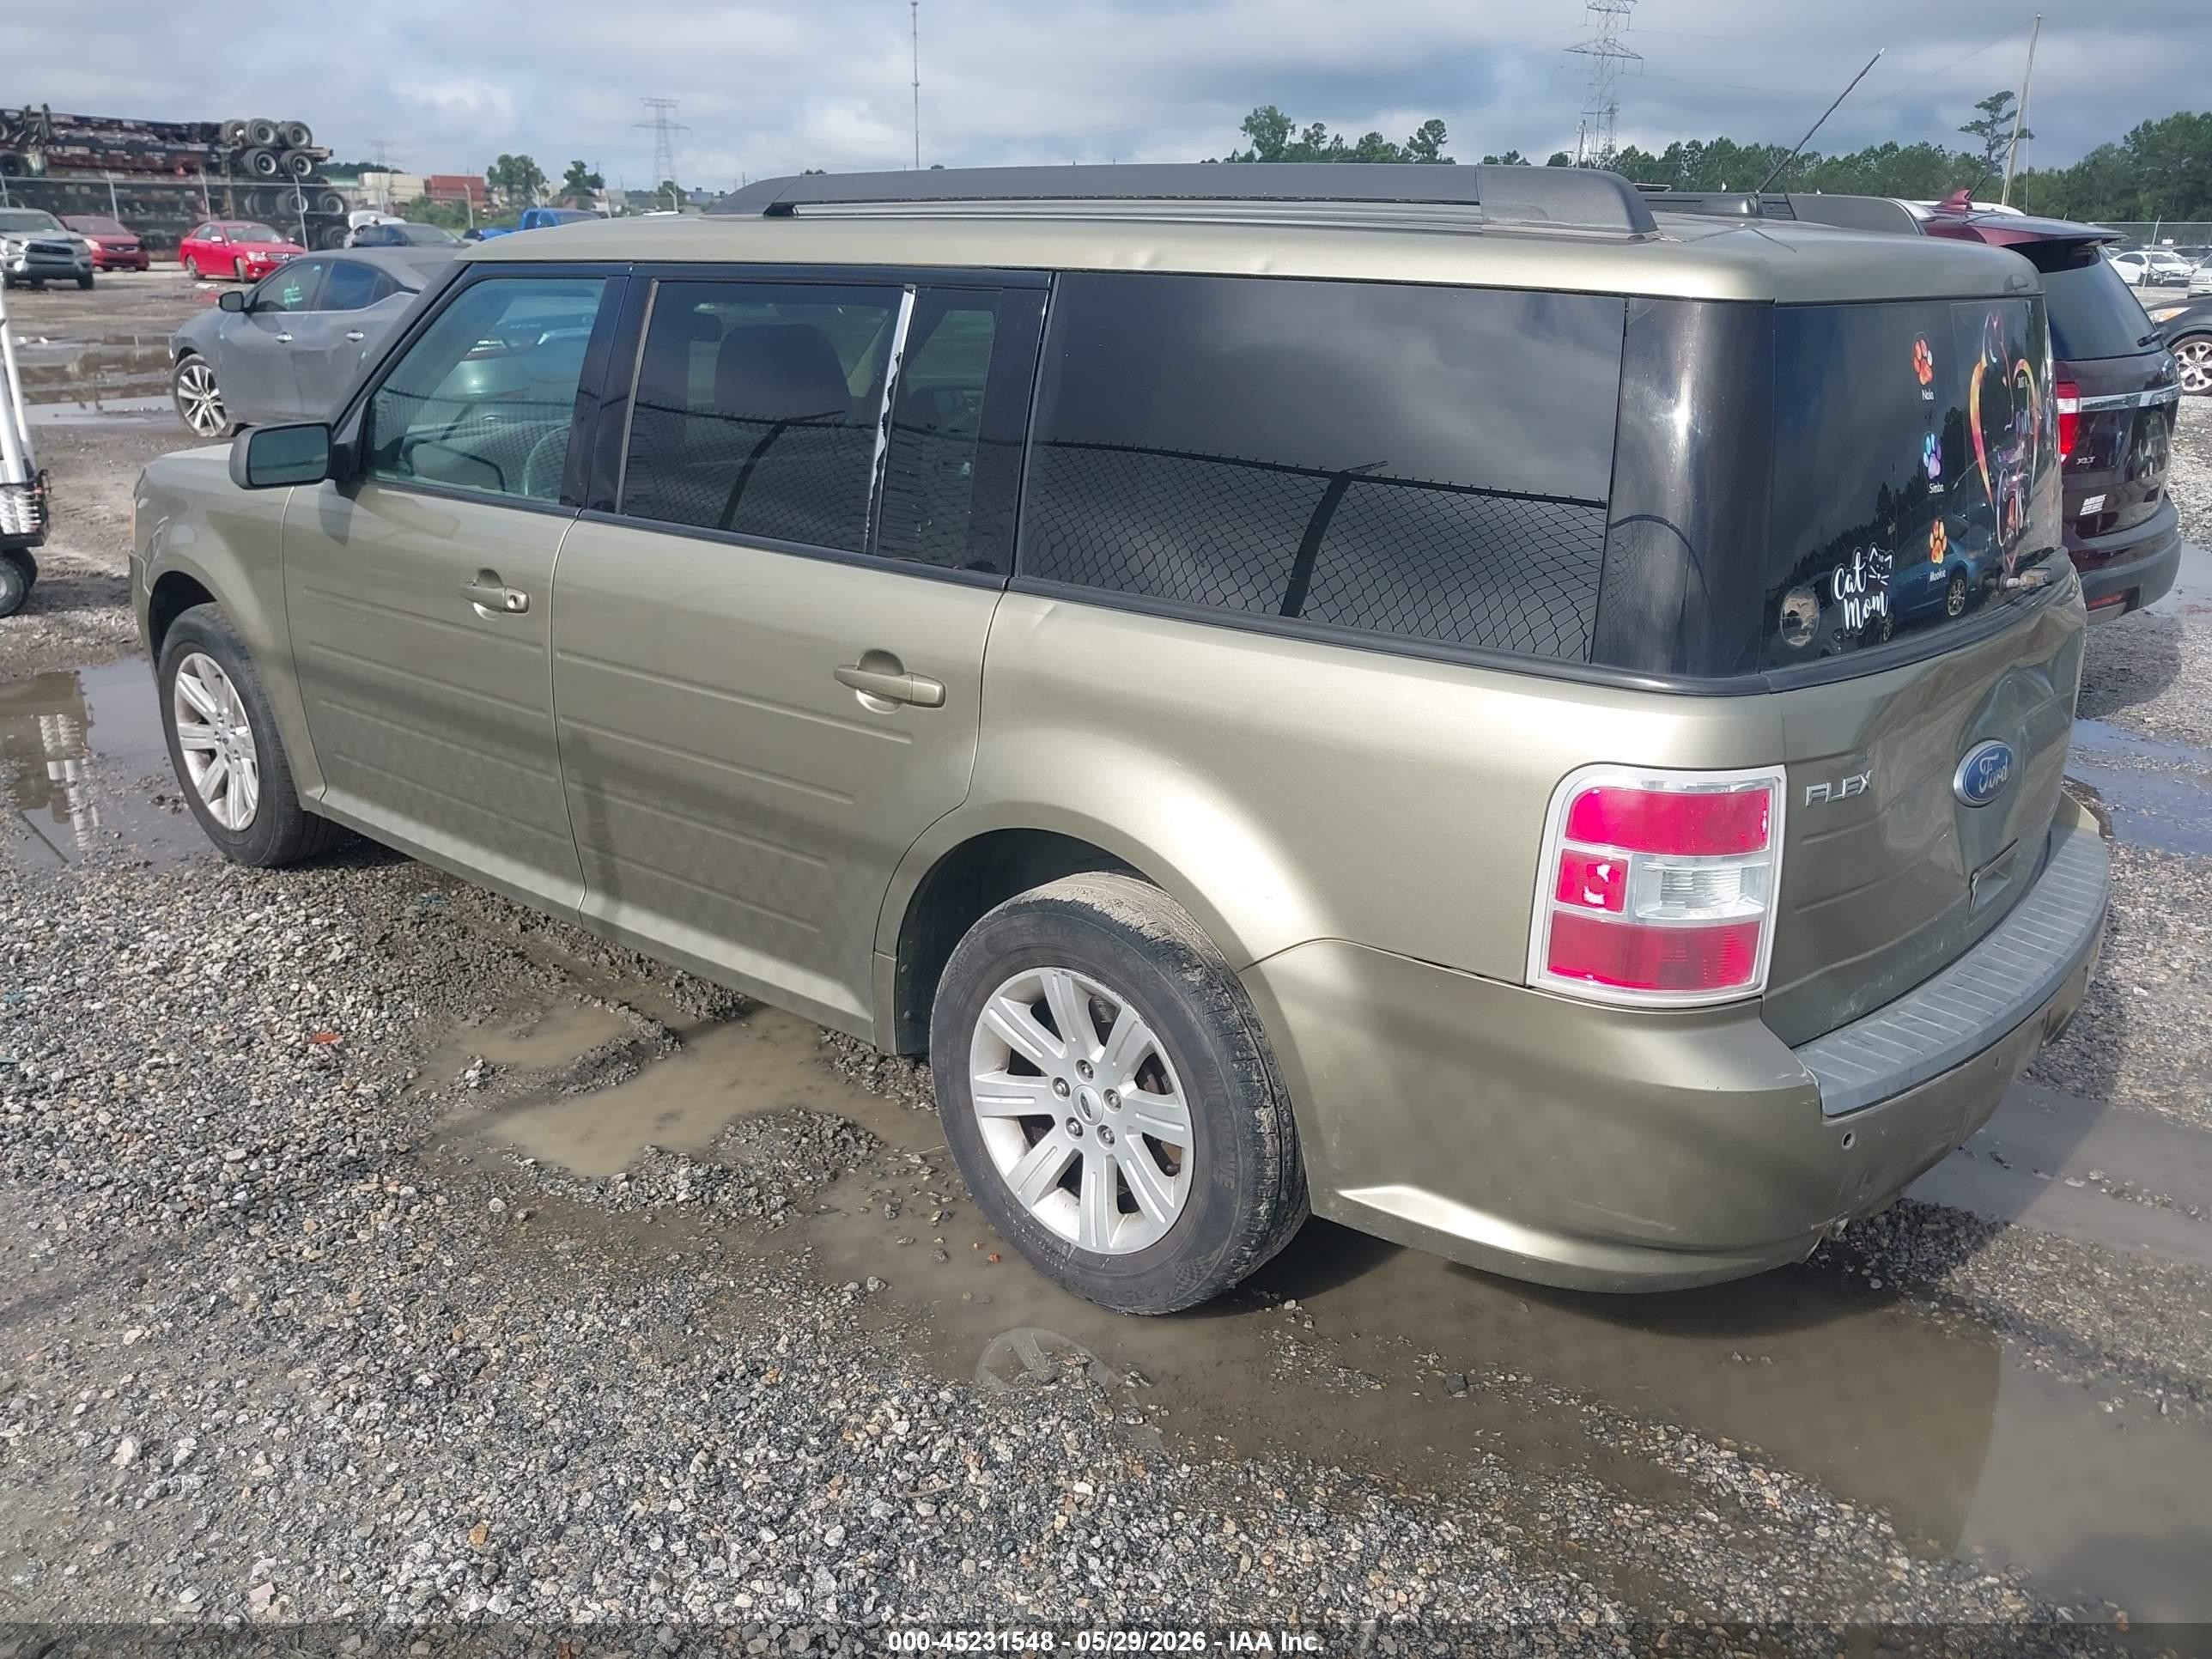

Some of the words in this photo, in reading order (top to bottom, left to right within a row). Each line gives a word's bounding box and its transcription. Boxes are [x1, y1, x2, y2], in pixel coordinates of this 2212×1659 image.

[1922, 388, 1935, 400] Nala
[2075, 456, 2095, 465] XLT
[1929, 482, 1944, 494] Simba
[1834, 552, 1866, 599] Cat
[1844, 591, 1888, 630] Mom
[1805, 769, 1873, 808] FLEX
[1978, 752, 2008, 793] Ford
